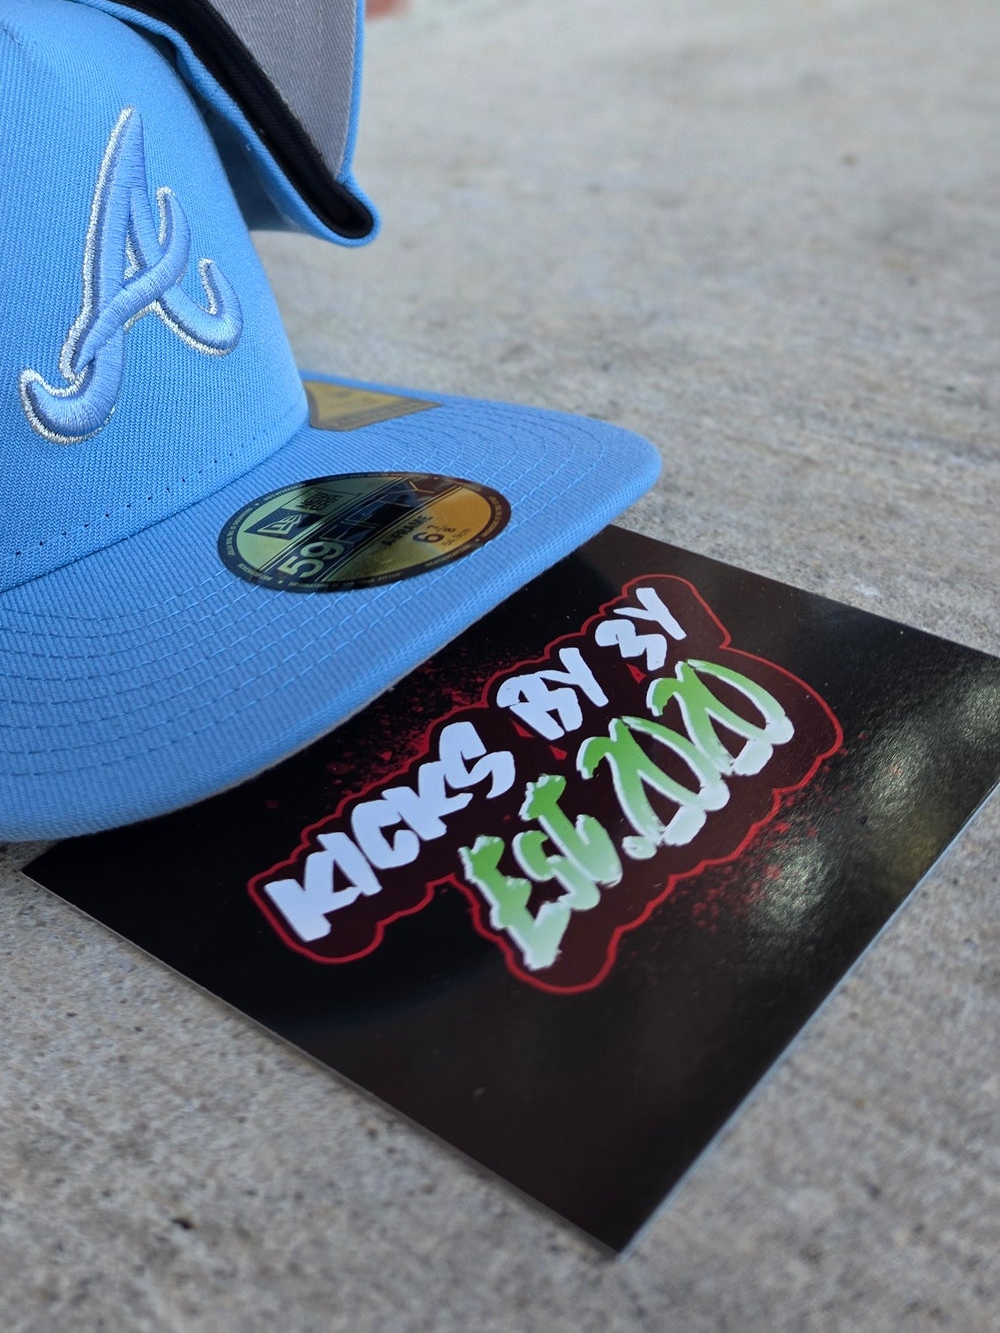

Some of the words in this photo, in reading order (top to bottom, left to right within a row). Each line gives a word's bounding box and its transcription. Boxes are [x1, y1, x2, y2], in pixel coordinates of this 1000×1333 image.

[19, 104, 244, 445] A
[264, 721, 516, 942] KICKS
[496, 647, 609, 741] BY
[576, 658, 795, 847] 2020
